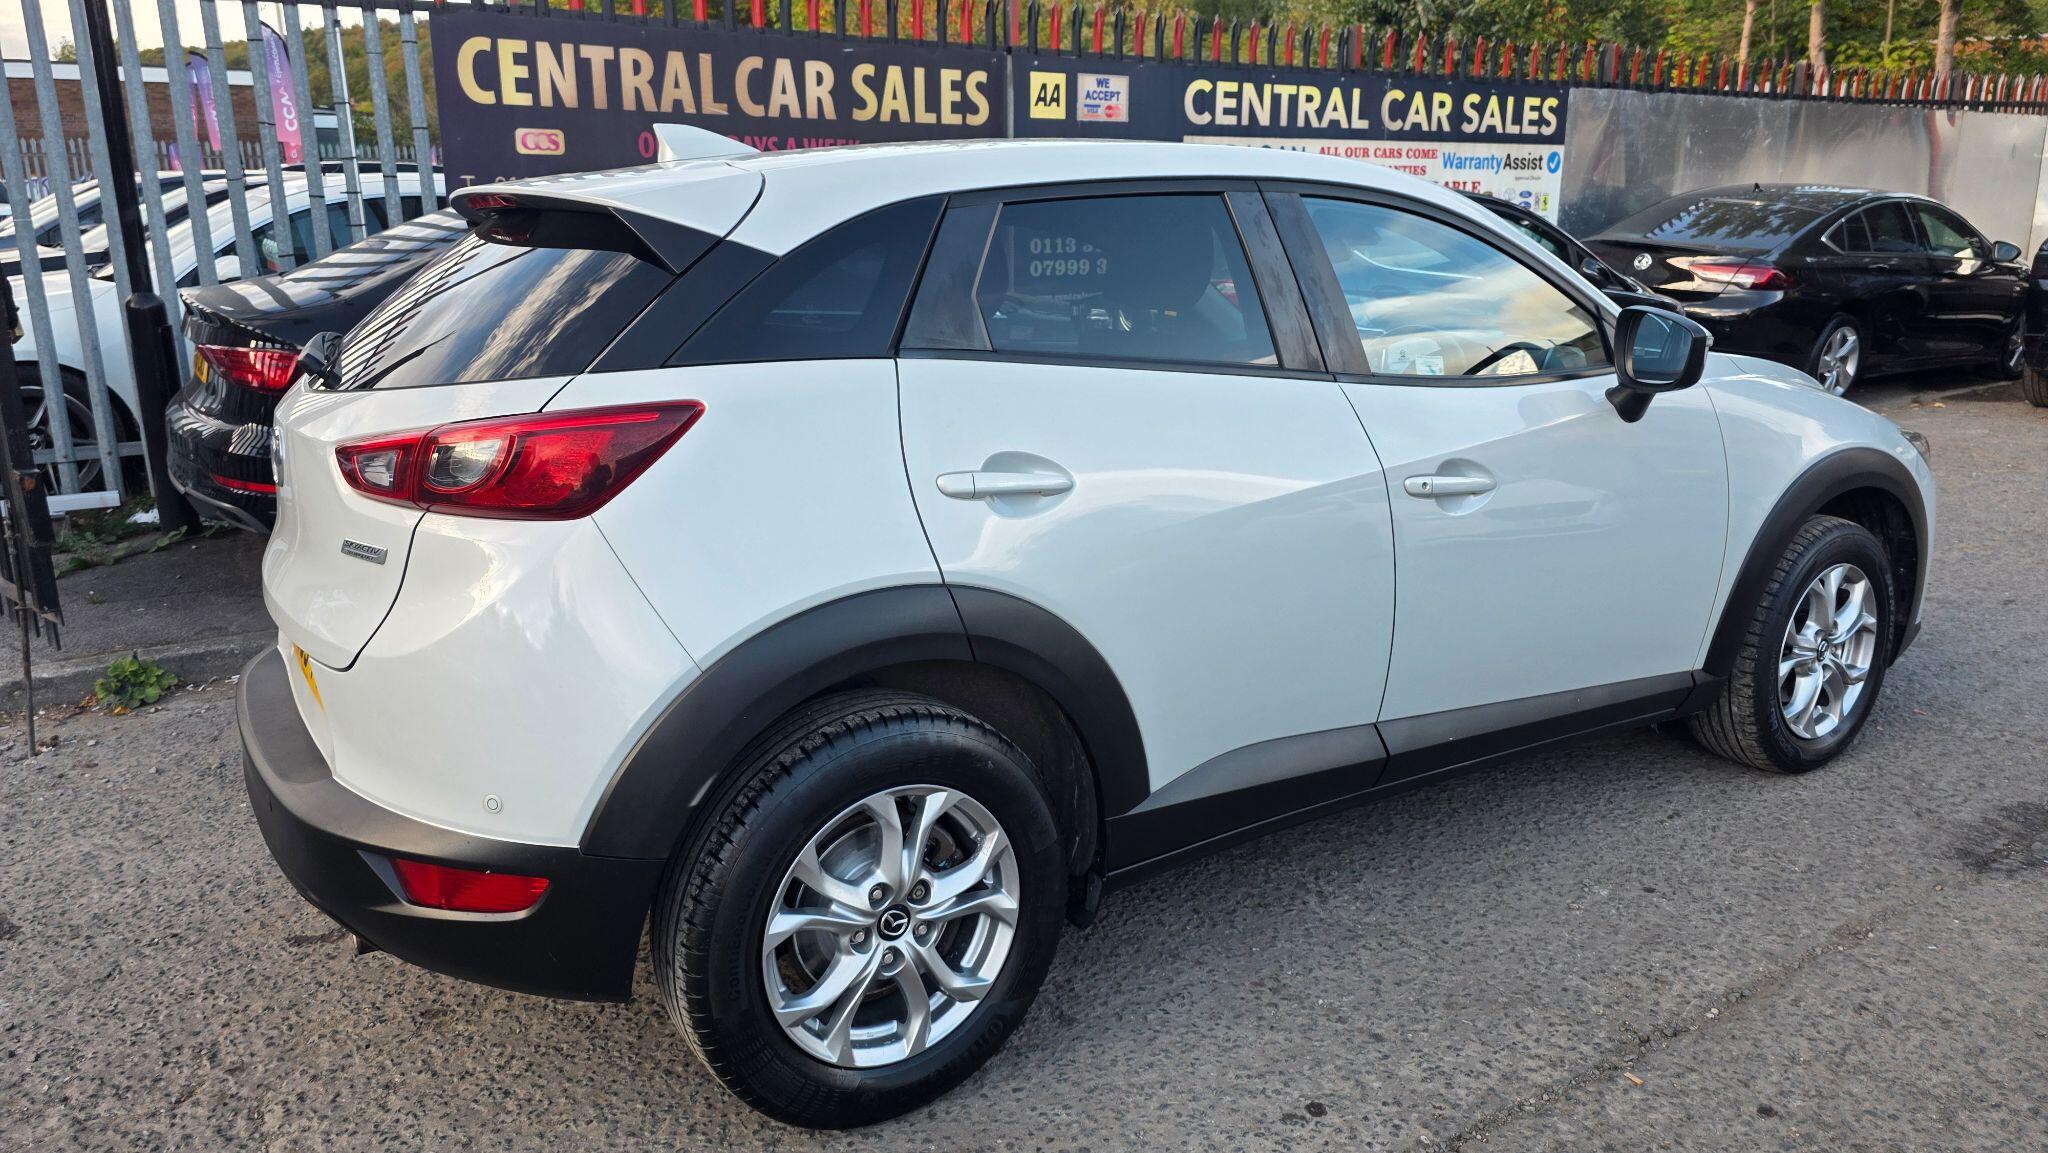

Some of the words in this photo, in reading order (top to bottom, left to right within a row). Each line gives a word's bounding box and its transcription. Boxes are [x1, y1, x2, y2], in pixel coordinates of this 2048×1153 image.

[457, 36, 729, 115] CENTRAL
[735, 56, 837, 120] CAR
[851, 63, 990, 126] SALES
[1096, 78, 1110, 88] WE
[1035, 83, 1060, 107] AA
[1085, 90, 1120, 102] ACCEPT
[1184, 79, 1369, 130] CENTRAL
[1381, 89, 1451, 132] CAR
[1461, 93, 1559, 136] SALES
[1319, 146, 1339, 157] ALL
[1345, 147, 1370, 158] OUR
[1374, 148, 1402, 159] CARS
[1406, 148, 1438, 160] COME
[1030, 237, 1077, 254] 0113
[1030, 258, 1090, 276] 07999
